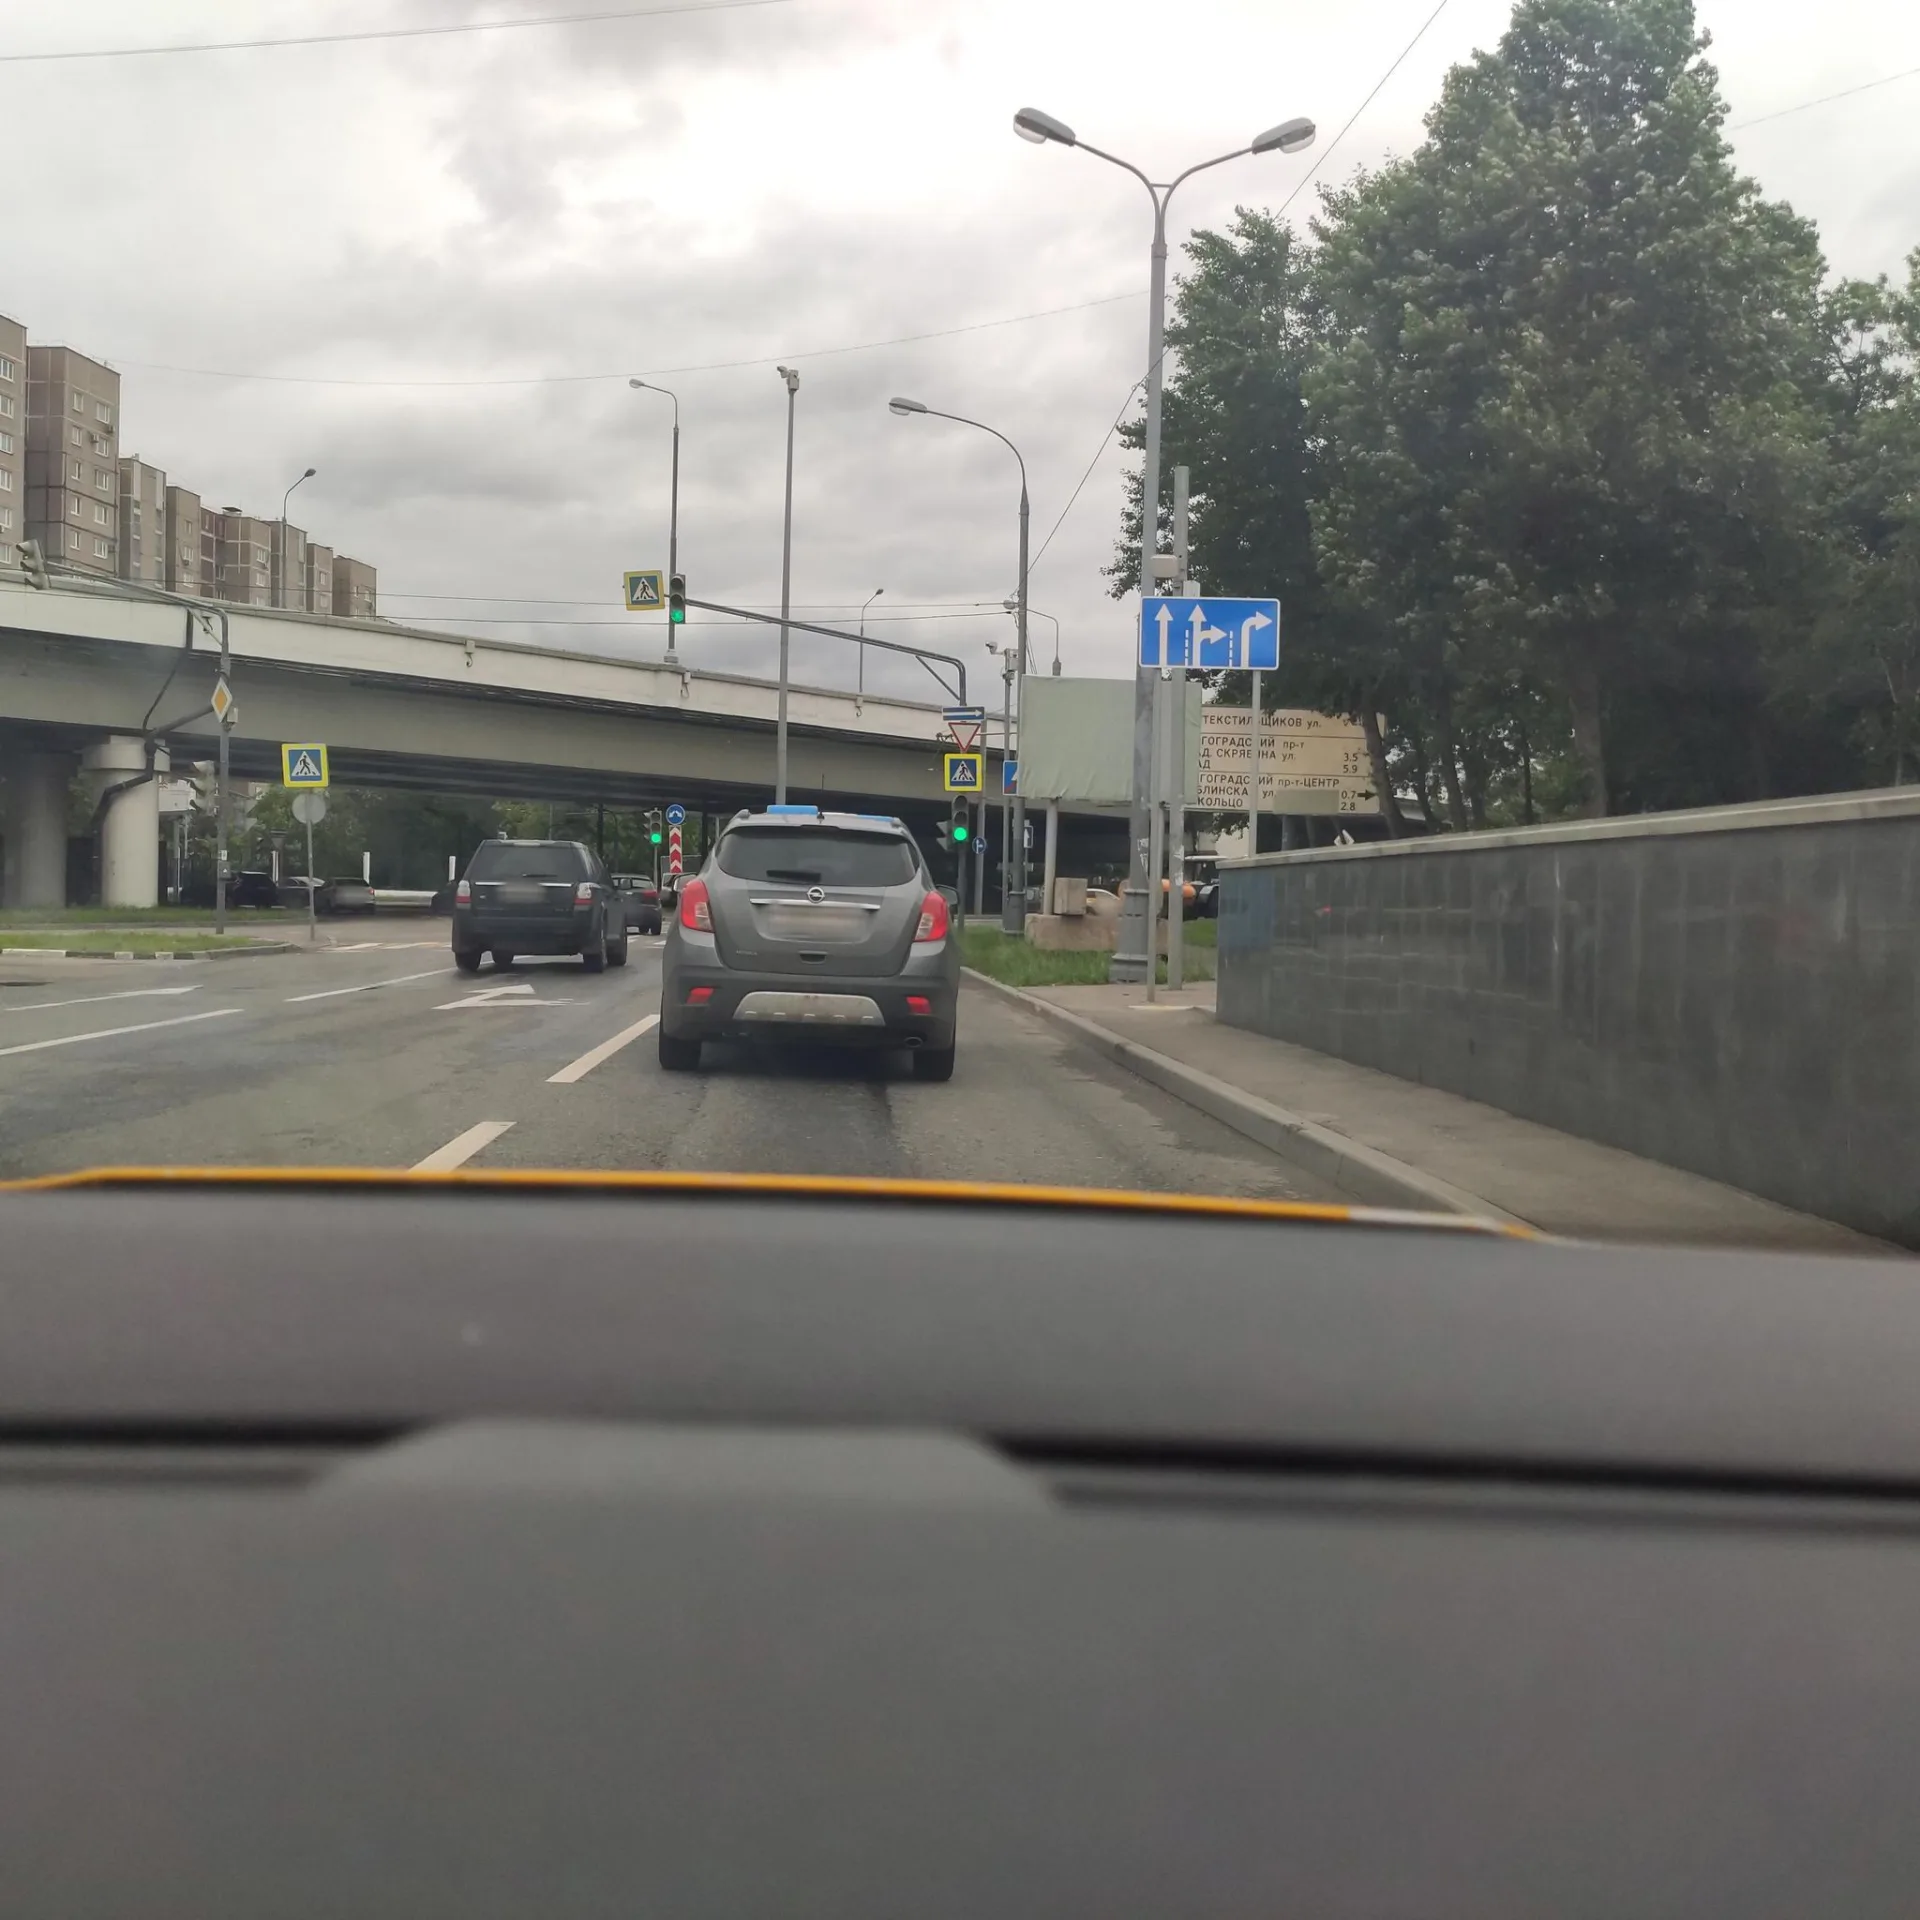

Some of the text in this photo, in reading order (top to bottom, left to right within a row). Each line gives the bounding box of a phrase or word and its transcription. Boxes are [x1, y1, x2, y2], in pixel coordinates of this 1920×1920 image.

[1203, 715, 1321, 729] ТЕКСТИЛЩИКОВ ул.
[1201, 736, 1304, 750] ГОГРАДСИЙ пр-т
[1282, 753, 1296, 762] ул.
[1343, 752, 1358, 762] 3.5
[1343, 764, 1358, 774] 5.9
[1200, 774, 1340, 788] ГОГРАДСИЙ пр-т-ЦЕНТР
[1197, 786, 1356, 800] БЛИНСКА ул. 0.7
[1198, 797, 1356, 811] КОЛЬЦО 2.8
